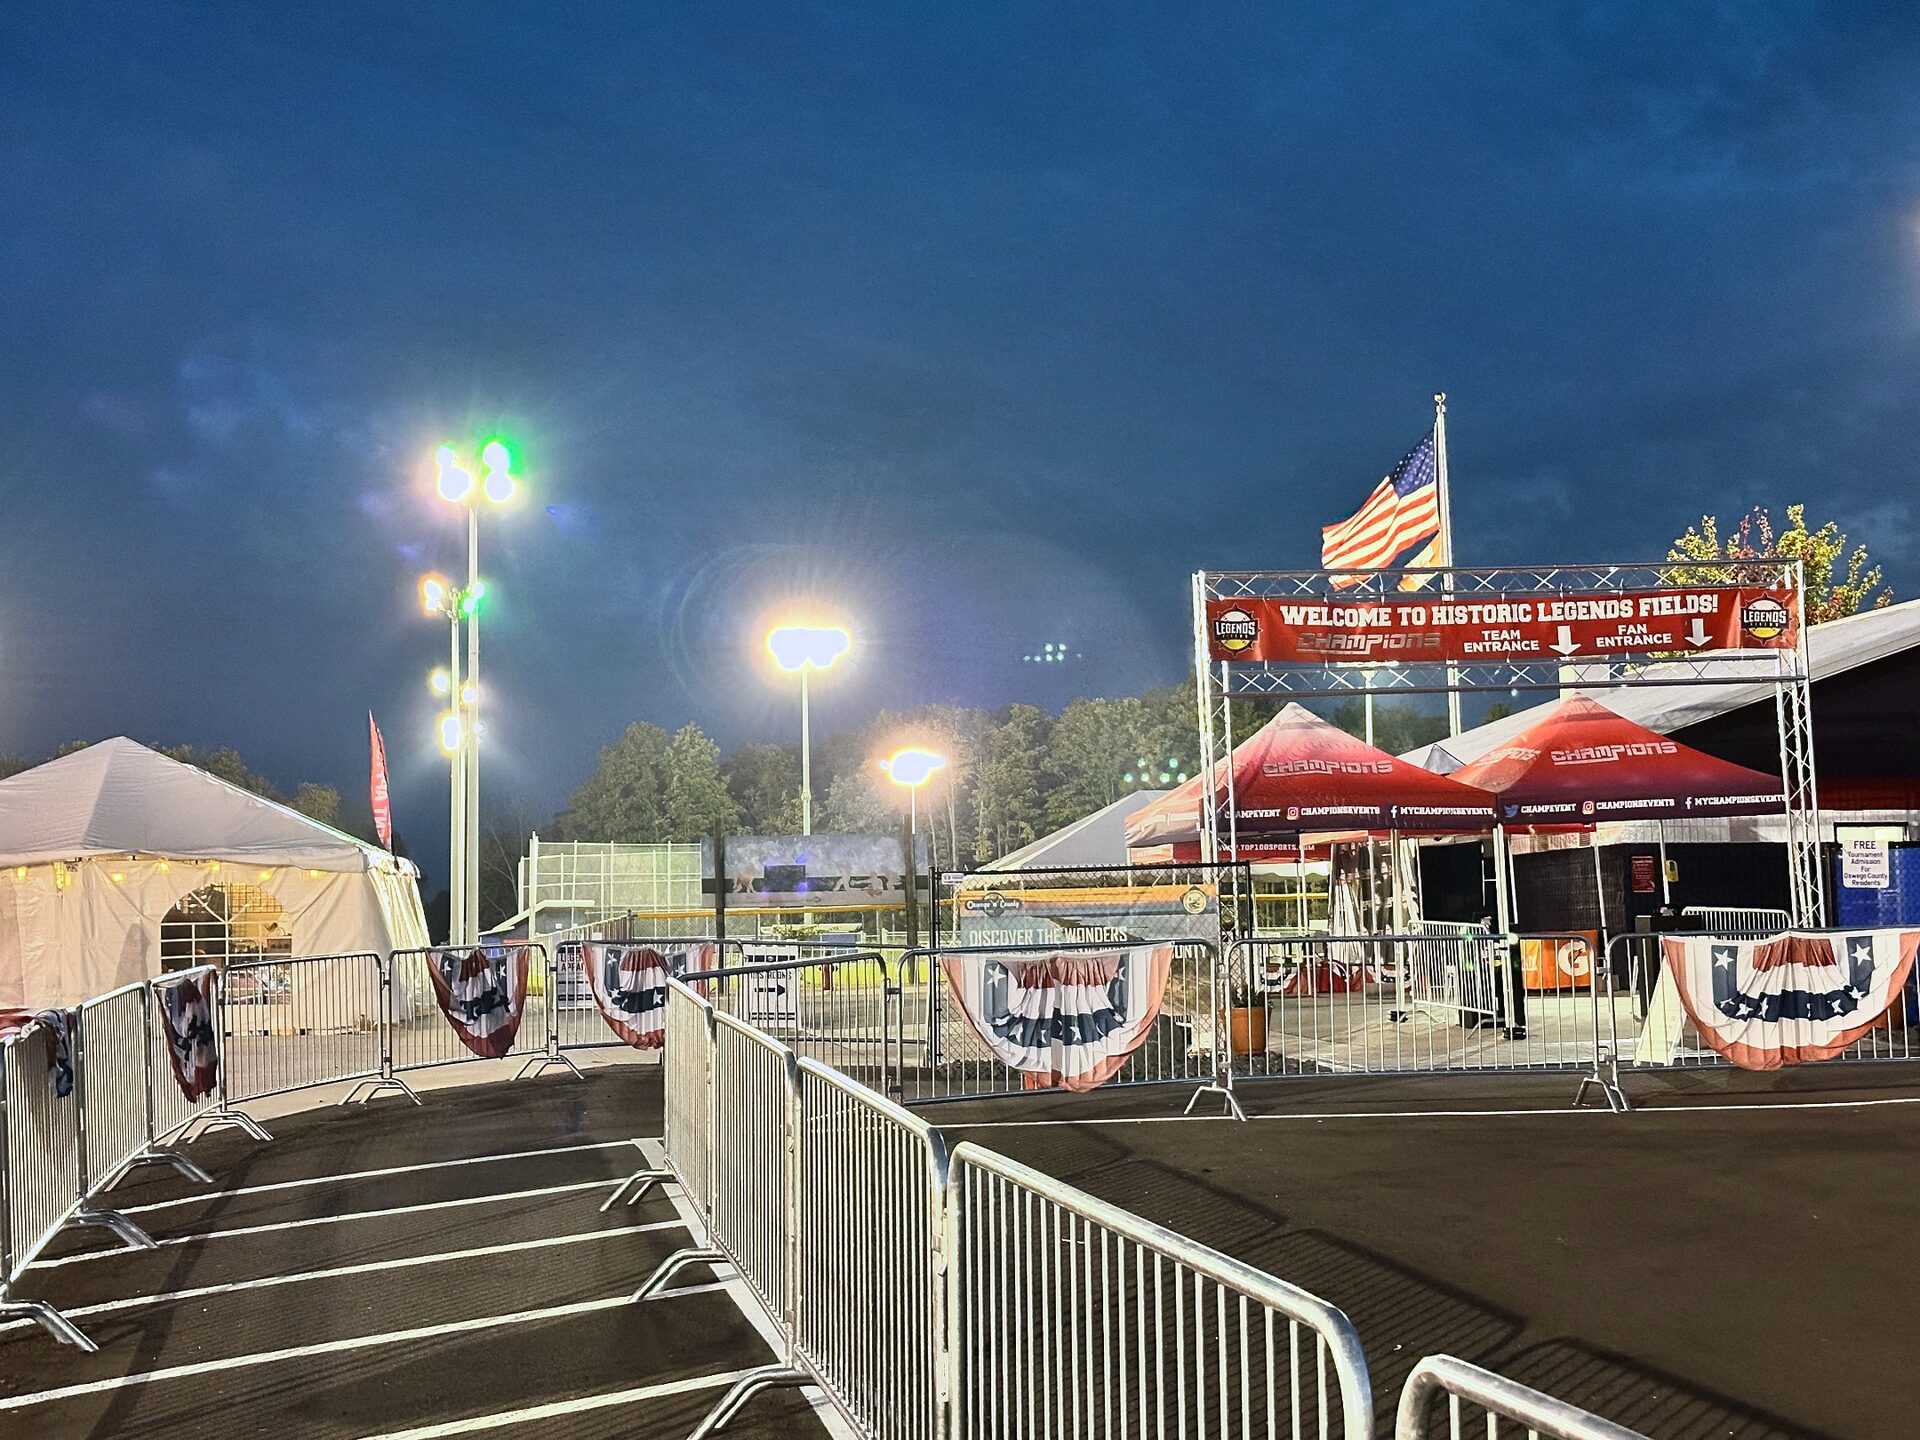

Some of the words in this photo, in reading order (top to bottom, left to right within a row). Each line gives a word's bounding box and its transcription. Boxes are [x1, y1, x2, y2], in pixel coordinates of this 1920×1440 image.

[1280, 605, 1392, 627] WELCOME
[1397, 606, 1427, 626] TO
[1431, 602, 1531, 626] HISTORIC
[1537, 597, 1634, 622] LEGENDS
[1639, 593, 1718, 618] FIELDS!
[1743, 609, 1787, 624] LEGENDS
[1215, 621, 1256, 636] LEGENDS
[1481, 629, 1521, 642] TEAM
[1618, 623, 1648, 636] FAN
[1296, 632, 1441, 655] CHAMPIONS
[1464, 639, 1540, 653] ENTRANCE
[1596, 632, 1673, 649] ENTRANCE
[1550, 741, 1678, 766] CHAMPIONS
[1262, 760, 1393, 778] CHAMPIONS
[1224, 809, 1281, 819] CAMPEVENT
[1521, 803, 1576, 814] CHAMPEVENT
[1853, 840, 1877, 850] FREE
[1867, 872, 1888, 880] County
[969, 930, 1033, 946] DISCOVER
[1038, 928, 1062, 945] THE
[1063, 926, 1128, 944] WONDERS
